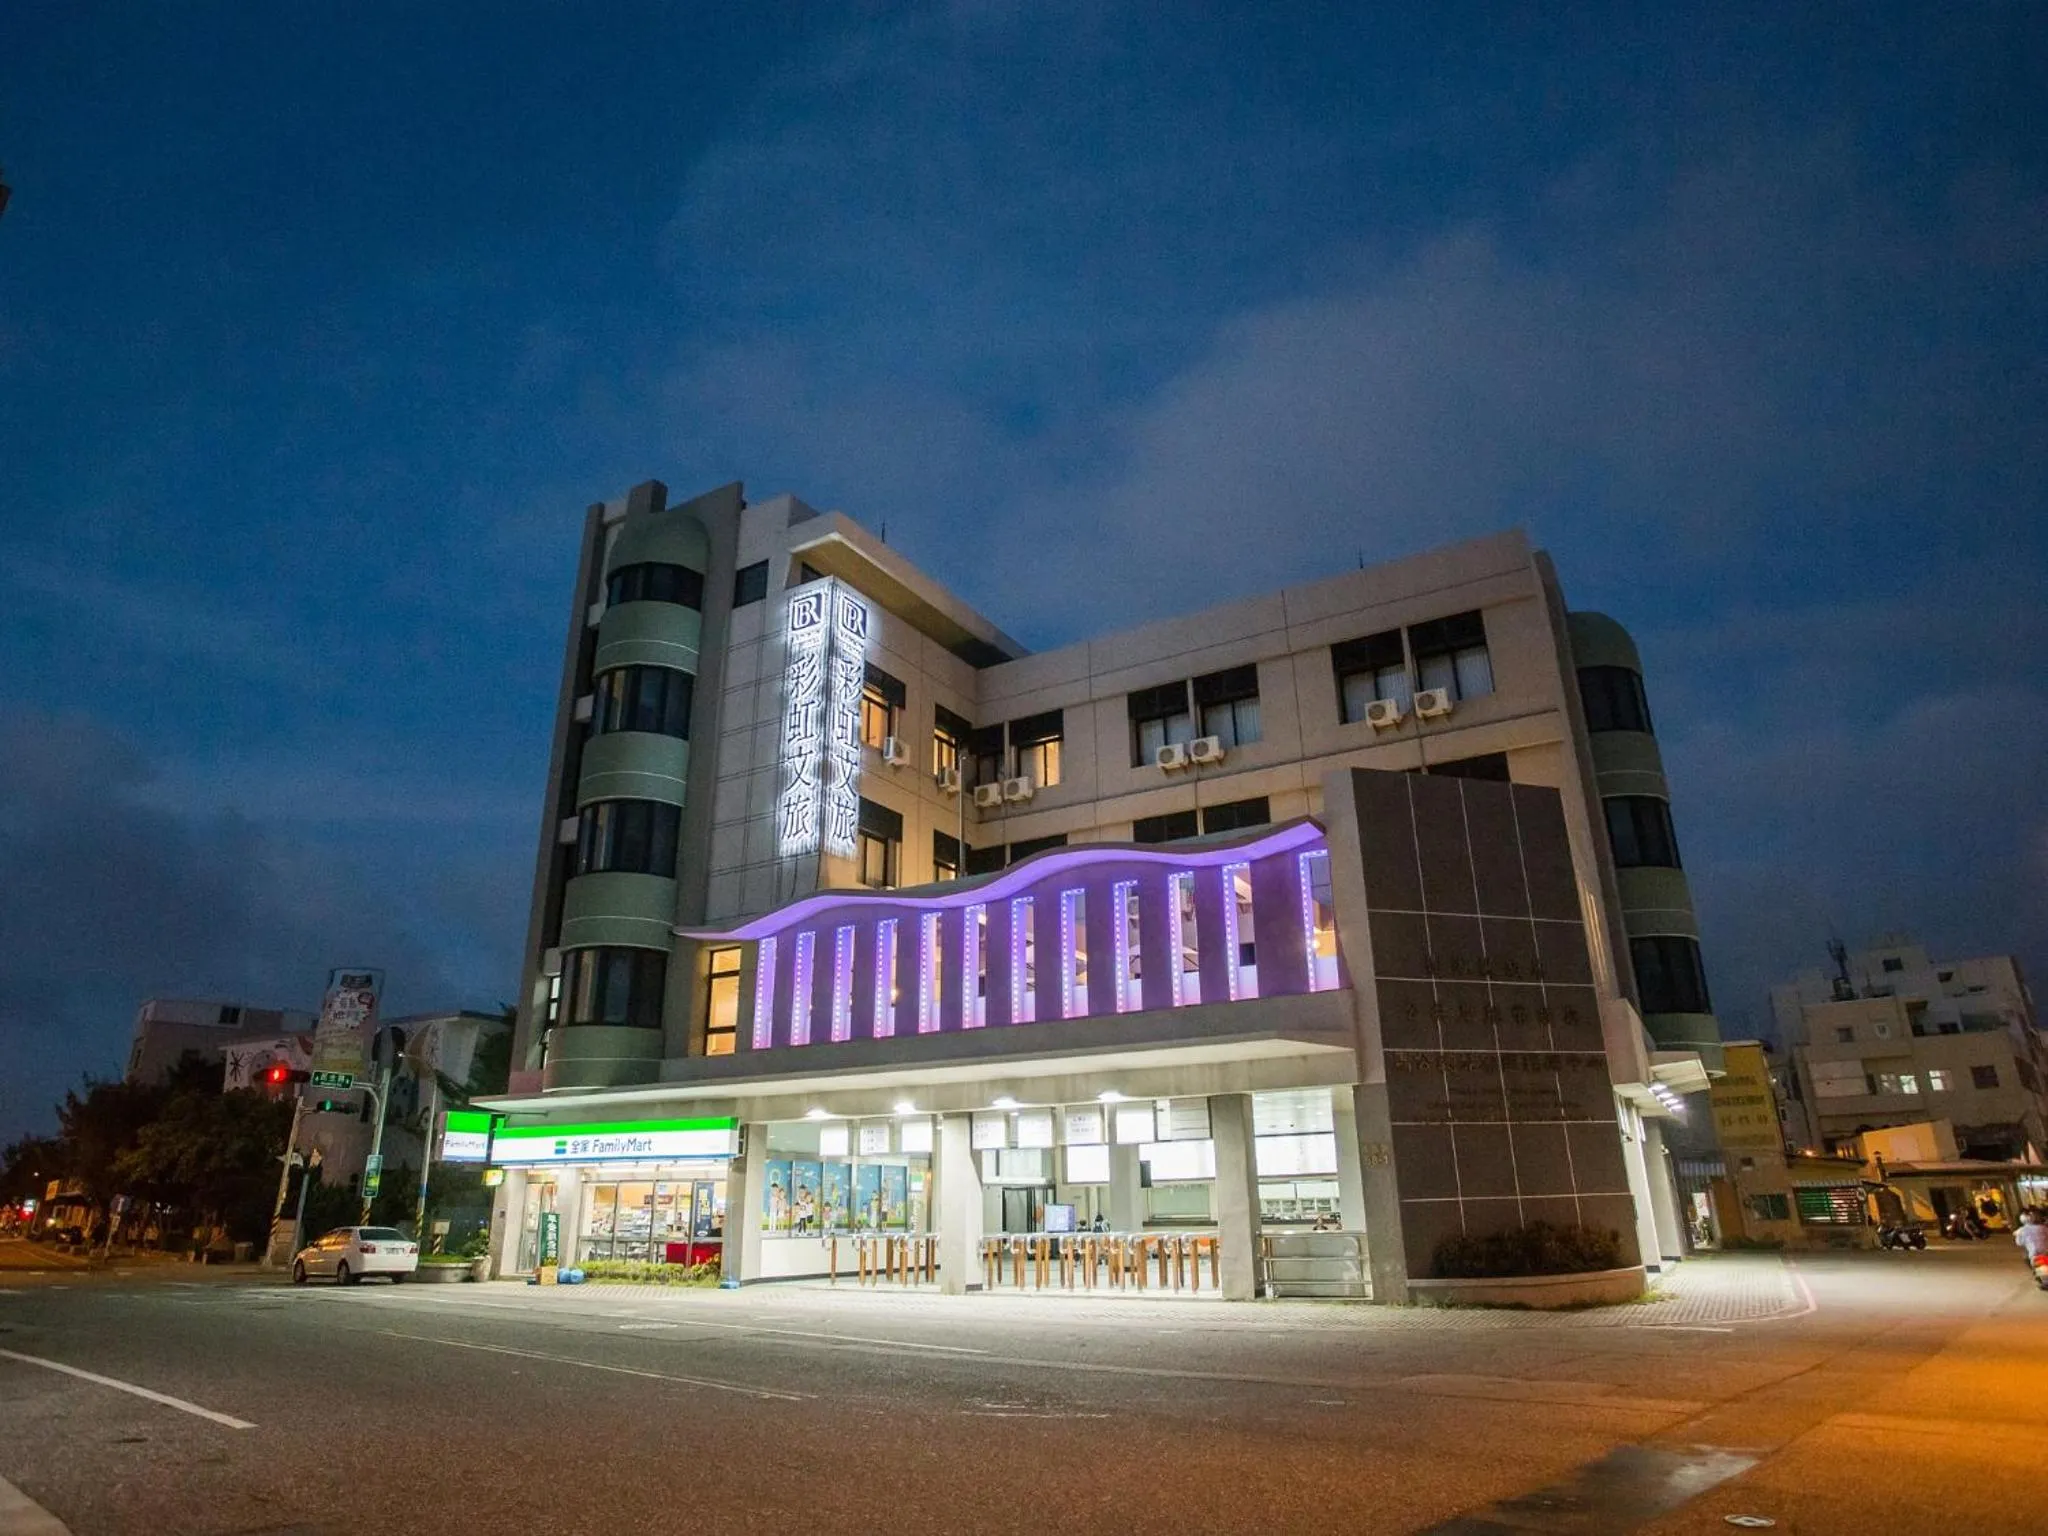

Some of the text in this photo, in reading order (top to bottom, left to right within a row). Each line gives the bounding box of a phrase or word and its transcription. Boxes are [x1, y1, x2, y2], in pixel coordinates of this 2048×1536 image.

[781, 653, 820, 840] 彩虹文旅
[832, 659, 862, 843] 彩虹文旅
[570, 1138, 652, 1154] 全家 FamilyMart
